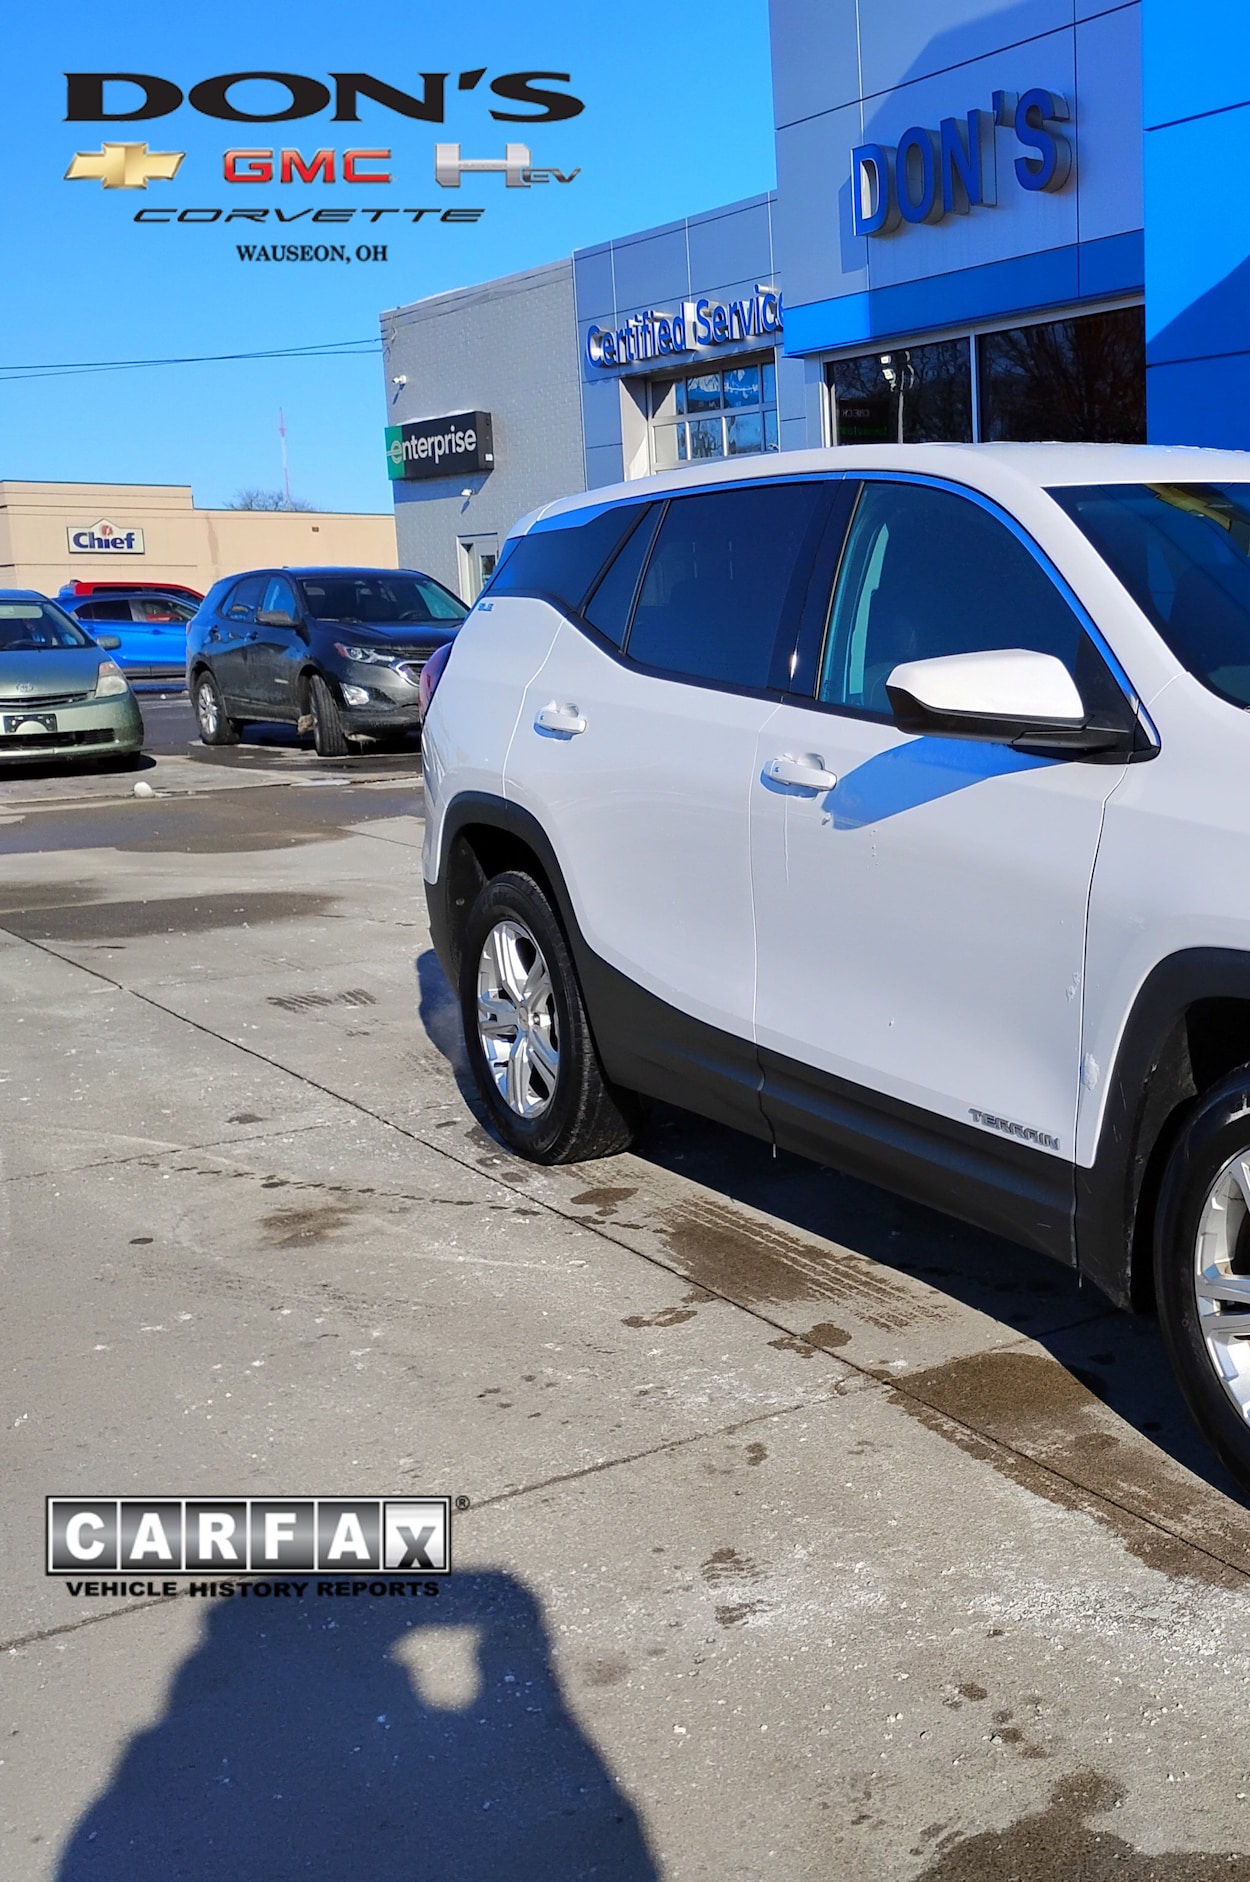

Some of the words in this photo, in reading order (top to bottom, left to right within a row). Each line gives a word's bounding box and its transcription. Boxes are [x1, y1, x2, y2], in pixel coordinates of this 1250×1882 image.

[849, 87, 1071, 237] DON'S
[586, 302, 688, 368] Certified
[387, 425, 477, 464] enterprise
[73, 531, 135, 549] Chief
[967, 1107, 1060, 1150] TERRAIN
